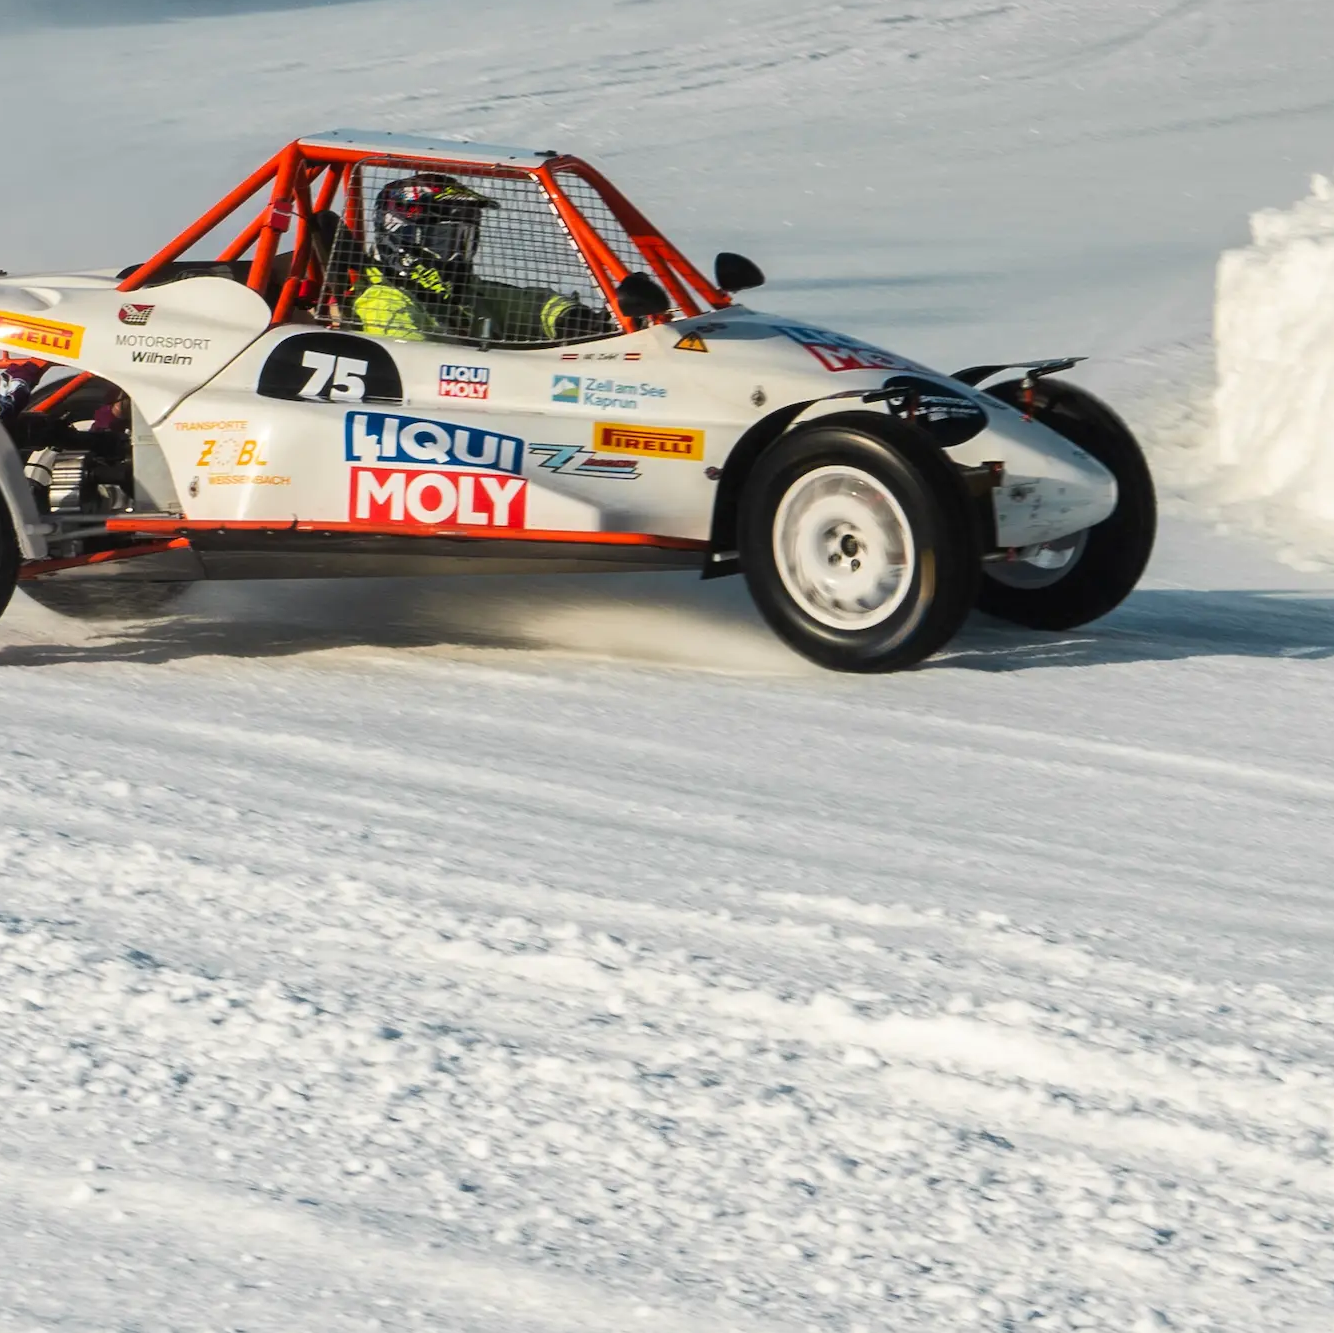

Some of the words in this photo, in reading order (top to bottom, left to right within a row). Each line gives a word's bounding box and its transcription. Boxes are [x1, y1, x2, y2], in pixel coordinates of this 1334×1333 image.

[115, 334, 211, 350] MOTORSPORT
[132, 351, 193, 365] Wilhelm
[297, 350, 369, 403] 75
[442, 366, 487, 382] LIQUI
[440, 381, 488, 398] MOLY
[585, 378, 614, 392] Zell
[615, 384, 636, 394] am
[639, 383, 667, 397] See
[584, 393, 637, 409] Kaprun
[175, 421, 248, 431] TRANSPORTE
[353, 415, 516, 471] LIQUI
[602, 428, 694, 454] PIRELLI
[356, 471, 525, 526] MOLY
